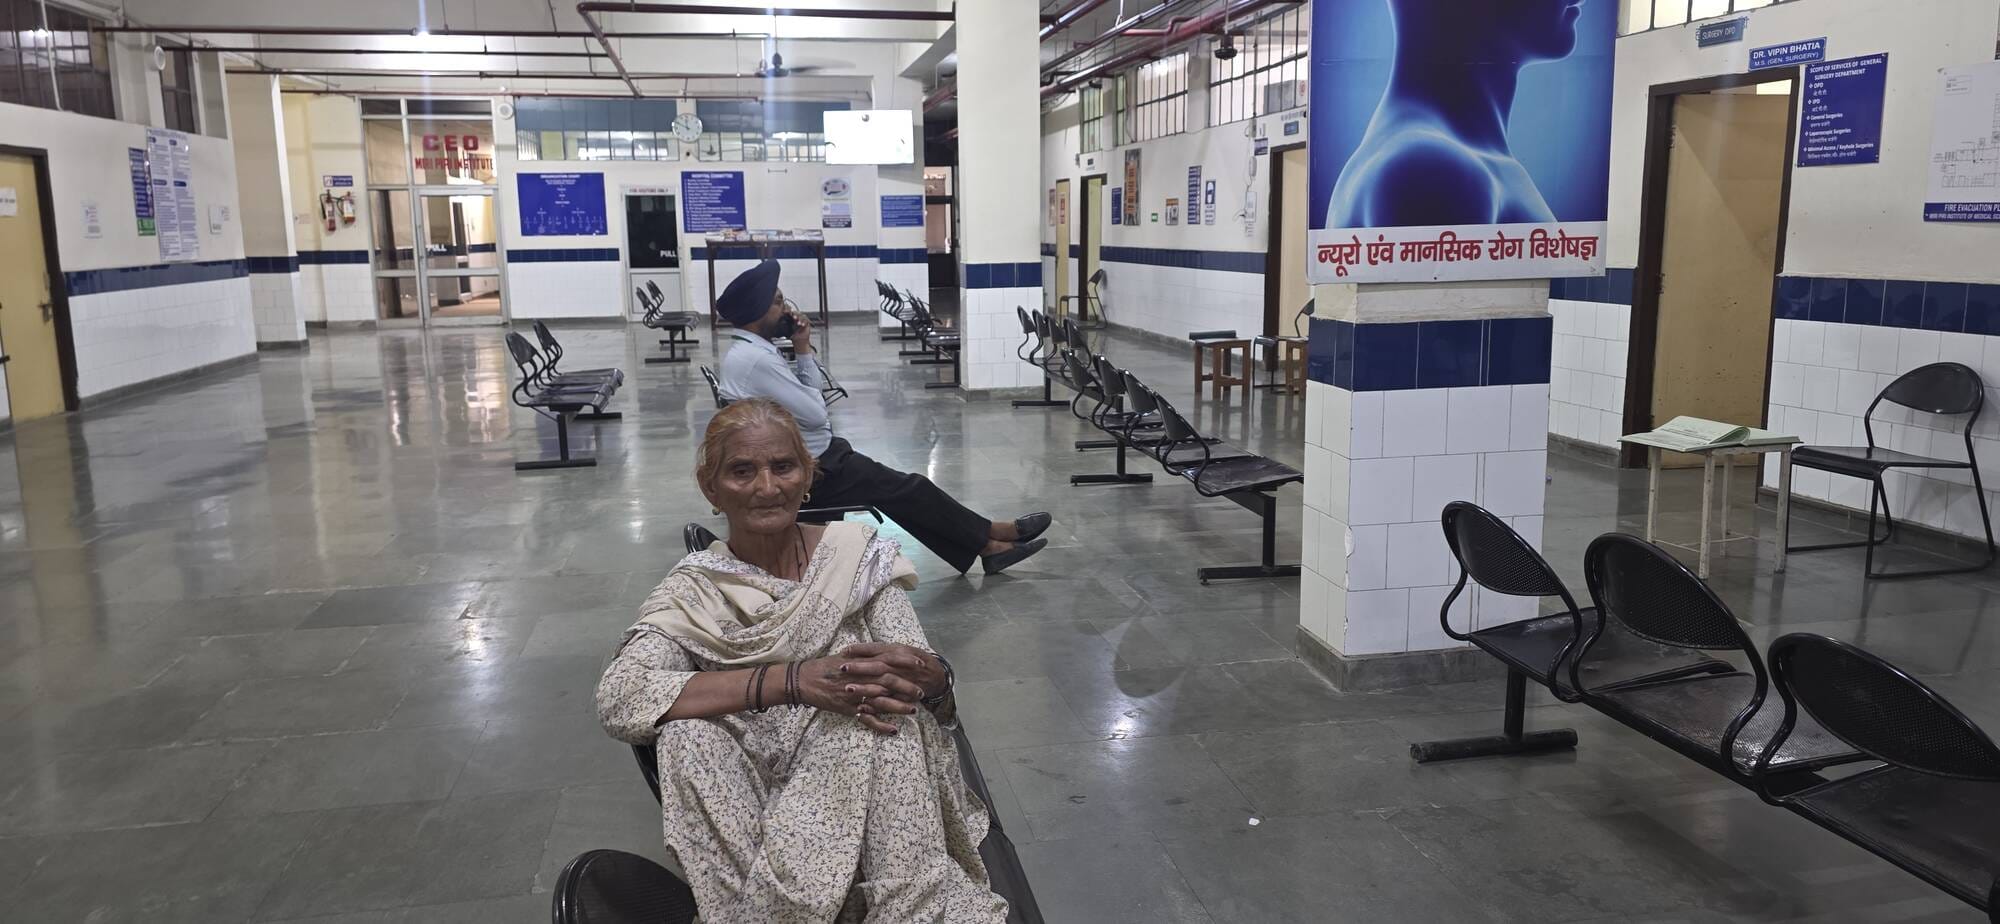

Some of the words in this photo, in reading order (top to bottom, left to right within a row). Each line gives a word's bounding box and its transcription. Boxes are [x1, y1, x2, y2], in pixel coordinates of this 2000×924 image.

[1702, 30, 1723, 40] SURGERY
[1753, 51, 1766, 59] DR.
[1767, 47, 1788, 57] VIPIN
[1789, 42, 1820, 53] BHATIA
[1810, 66, 1824, 74] SCOPE
[1831, 63, 1851, 71] SERVICES
[1860, 58, 1882, 66] GENERAL
[1835, 68, 1866, 78] DEPARTMENT
[423, 135, 478, 151] CEO
[1944, 203, 1957, 212] FIRE
[1957, 203, 1993, 212] EVACUATION
[660, 249, 677, 258] PULL
[1317, 234, 1361, 277] न्यूरो
[1400, 231, 1483, 262] मानसिक
[1488, 230, 1524, 261] रोग
[1529, 228, 1599, 261] विशेषज्ञ
